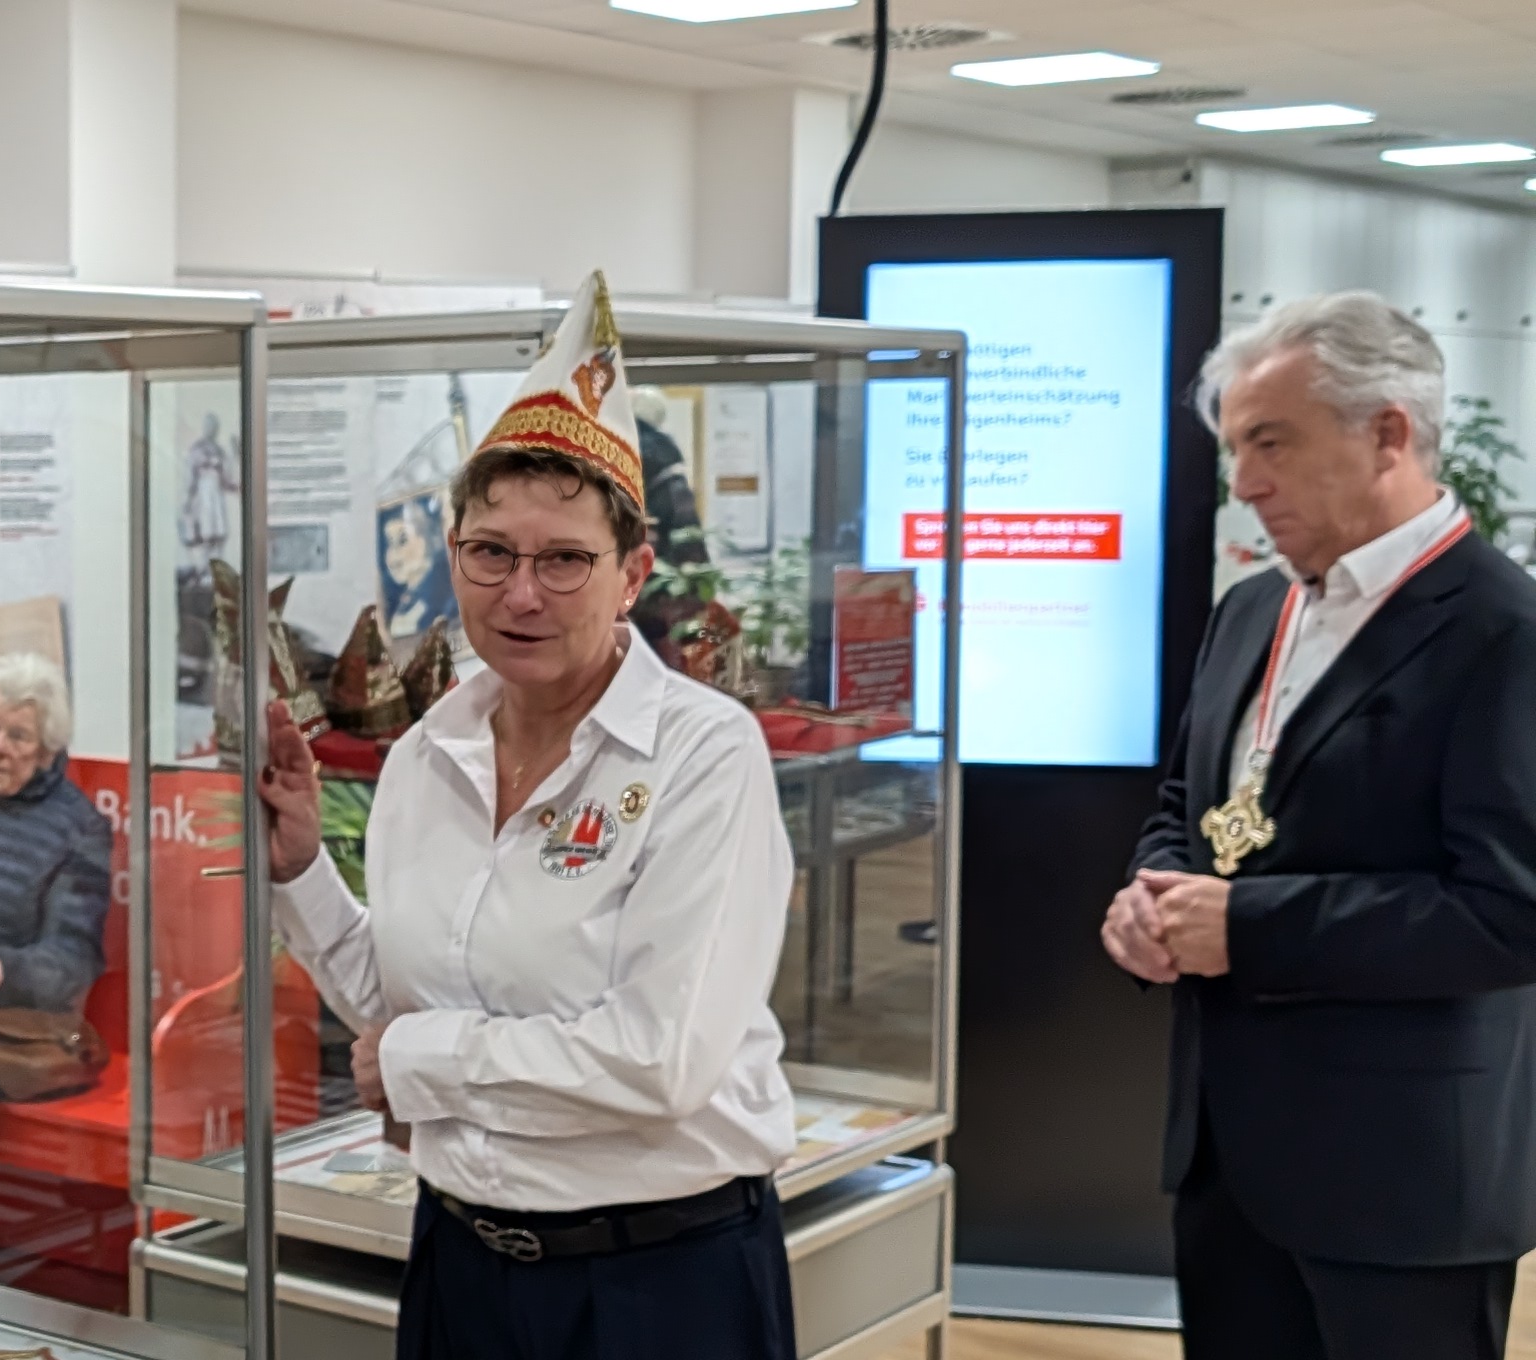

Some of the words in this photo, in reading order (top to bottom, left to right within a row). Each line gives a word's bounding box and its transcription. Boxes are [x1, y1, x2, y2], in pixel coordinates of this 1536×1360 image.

[968, 364, 1087, 380] verbindliche
[964, 412, 1072, 431] igenheims?
[95, 788, 209, 847] Bnk.
